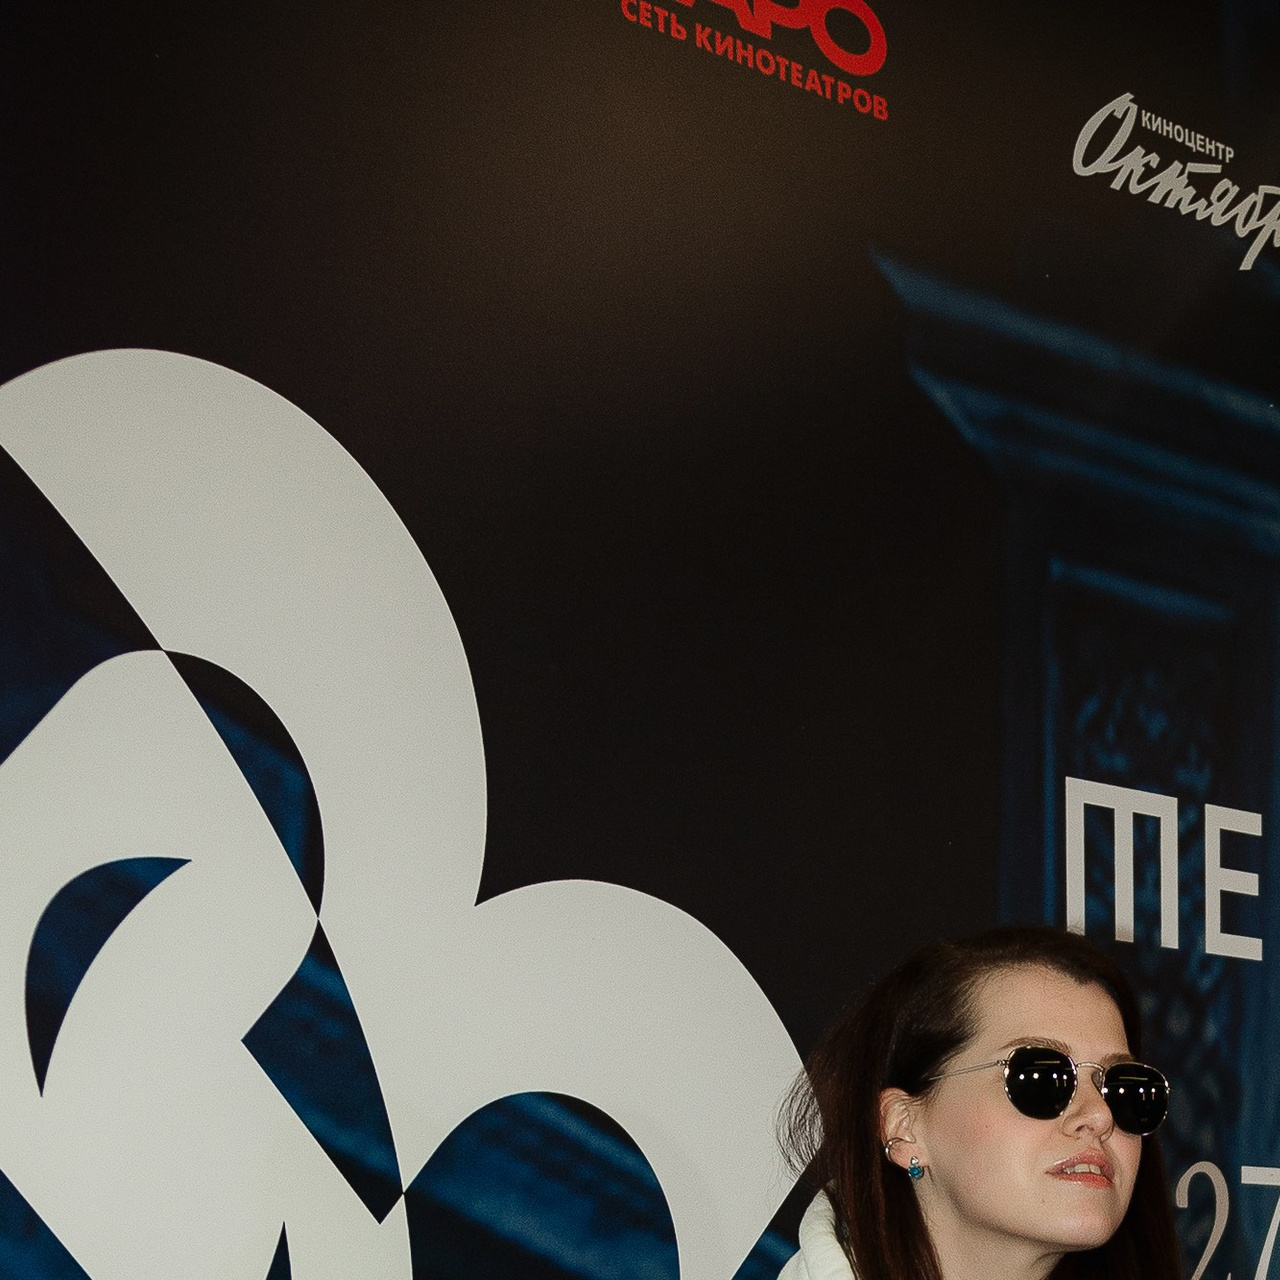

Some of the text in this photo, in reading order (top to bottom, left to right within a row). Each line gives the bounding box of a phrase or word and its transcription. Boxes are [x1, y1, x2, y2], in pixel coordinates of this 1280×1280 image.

[620, 0, 889, 121] СЕТЬ КИНОТЕАТРОВ
[1140, 109, 1235, 163] КИНОЦЕНТР
